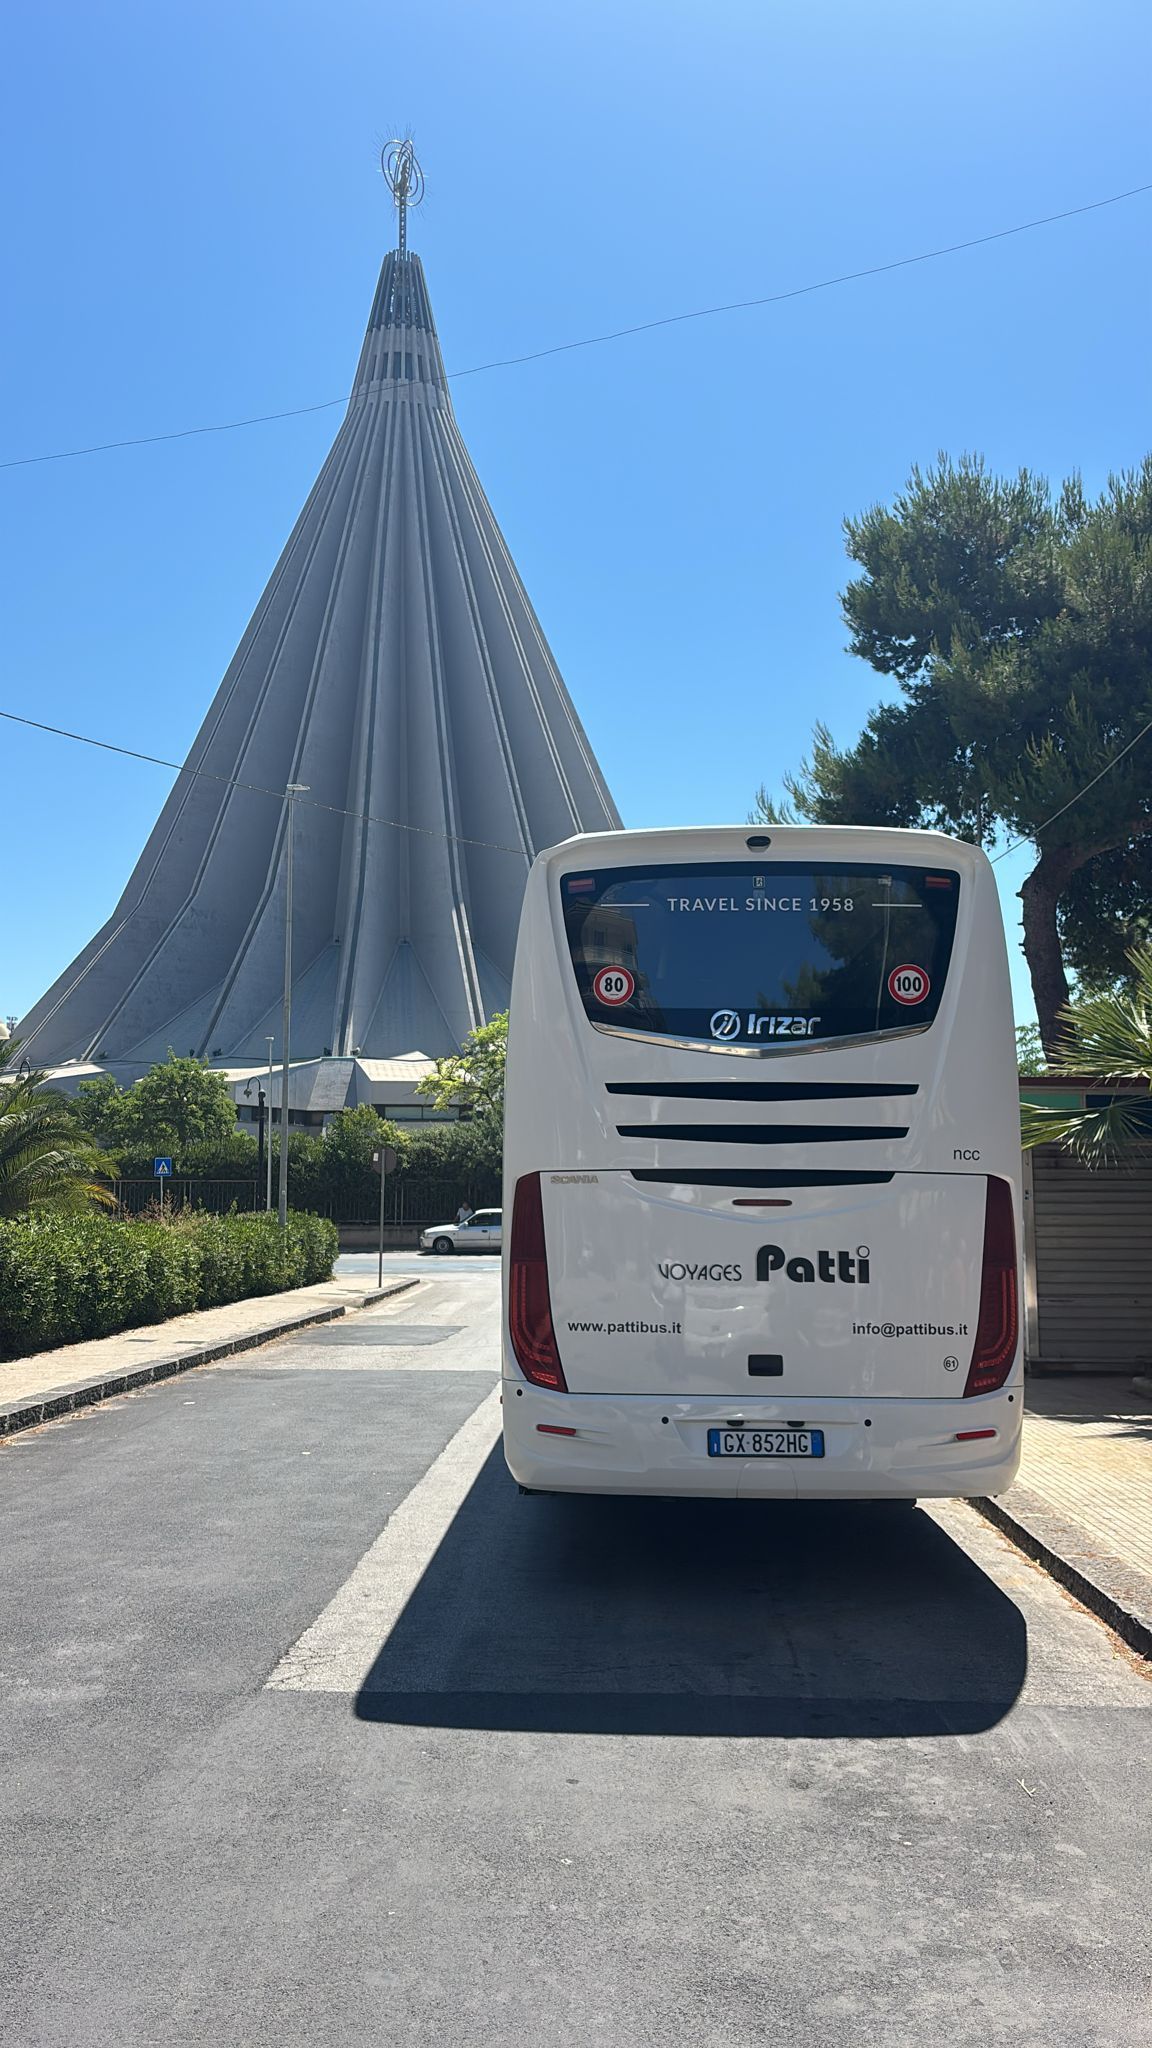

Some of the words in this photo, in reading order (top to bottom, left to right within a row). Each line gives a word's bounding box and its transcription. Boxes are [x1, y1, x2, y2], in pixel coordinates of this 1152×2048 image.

[667, 898, 739, 911] TRAVEL
[745, 898, 802, 911] SINCE
[809, 898, 854, 912] 1958
[604, 977, 623, 992] 80
[896, 976, 922, 992] 100
[747, 1013, 821, 1035] Irizar
[953, 1149, 980, 1161] ncc
[550, 1175, 599, 1184] SCANIA
[658, 1263, 743, 1281] VOYAGES
[756, 1244, 870, 1284] Patti
[567, 1321, 682, 1335] www.pattibus.it
[852, 1322, 968, 1338] info@pattibus.it
